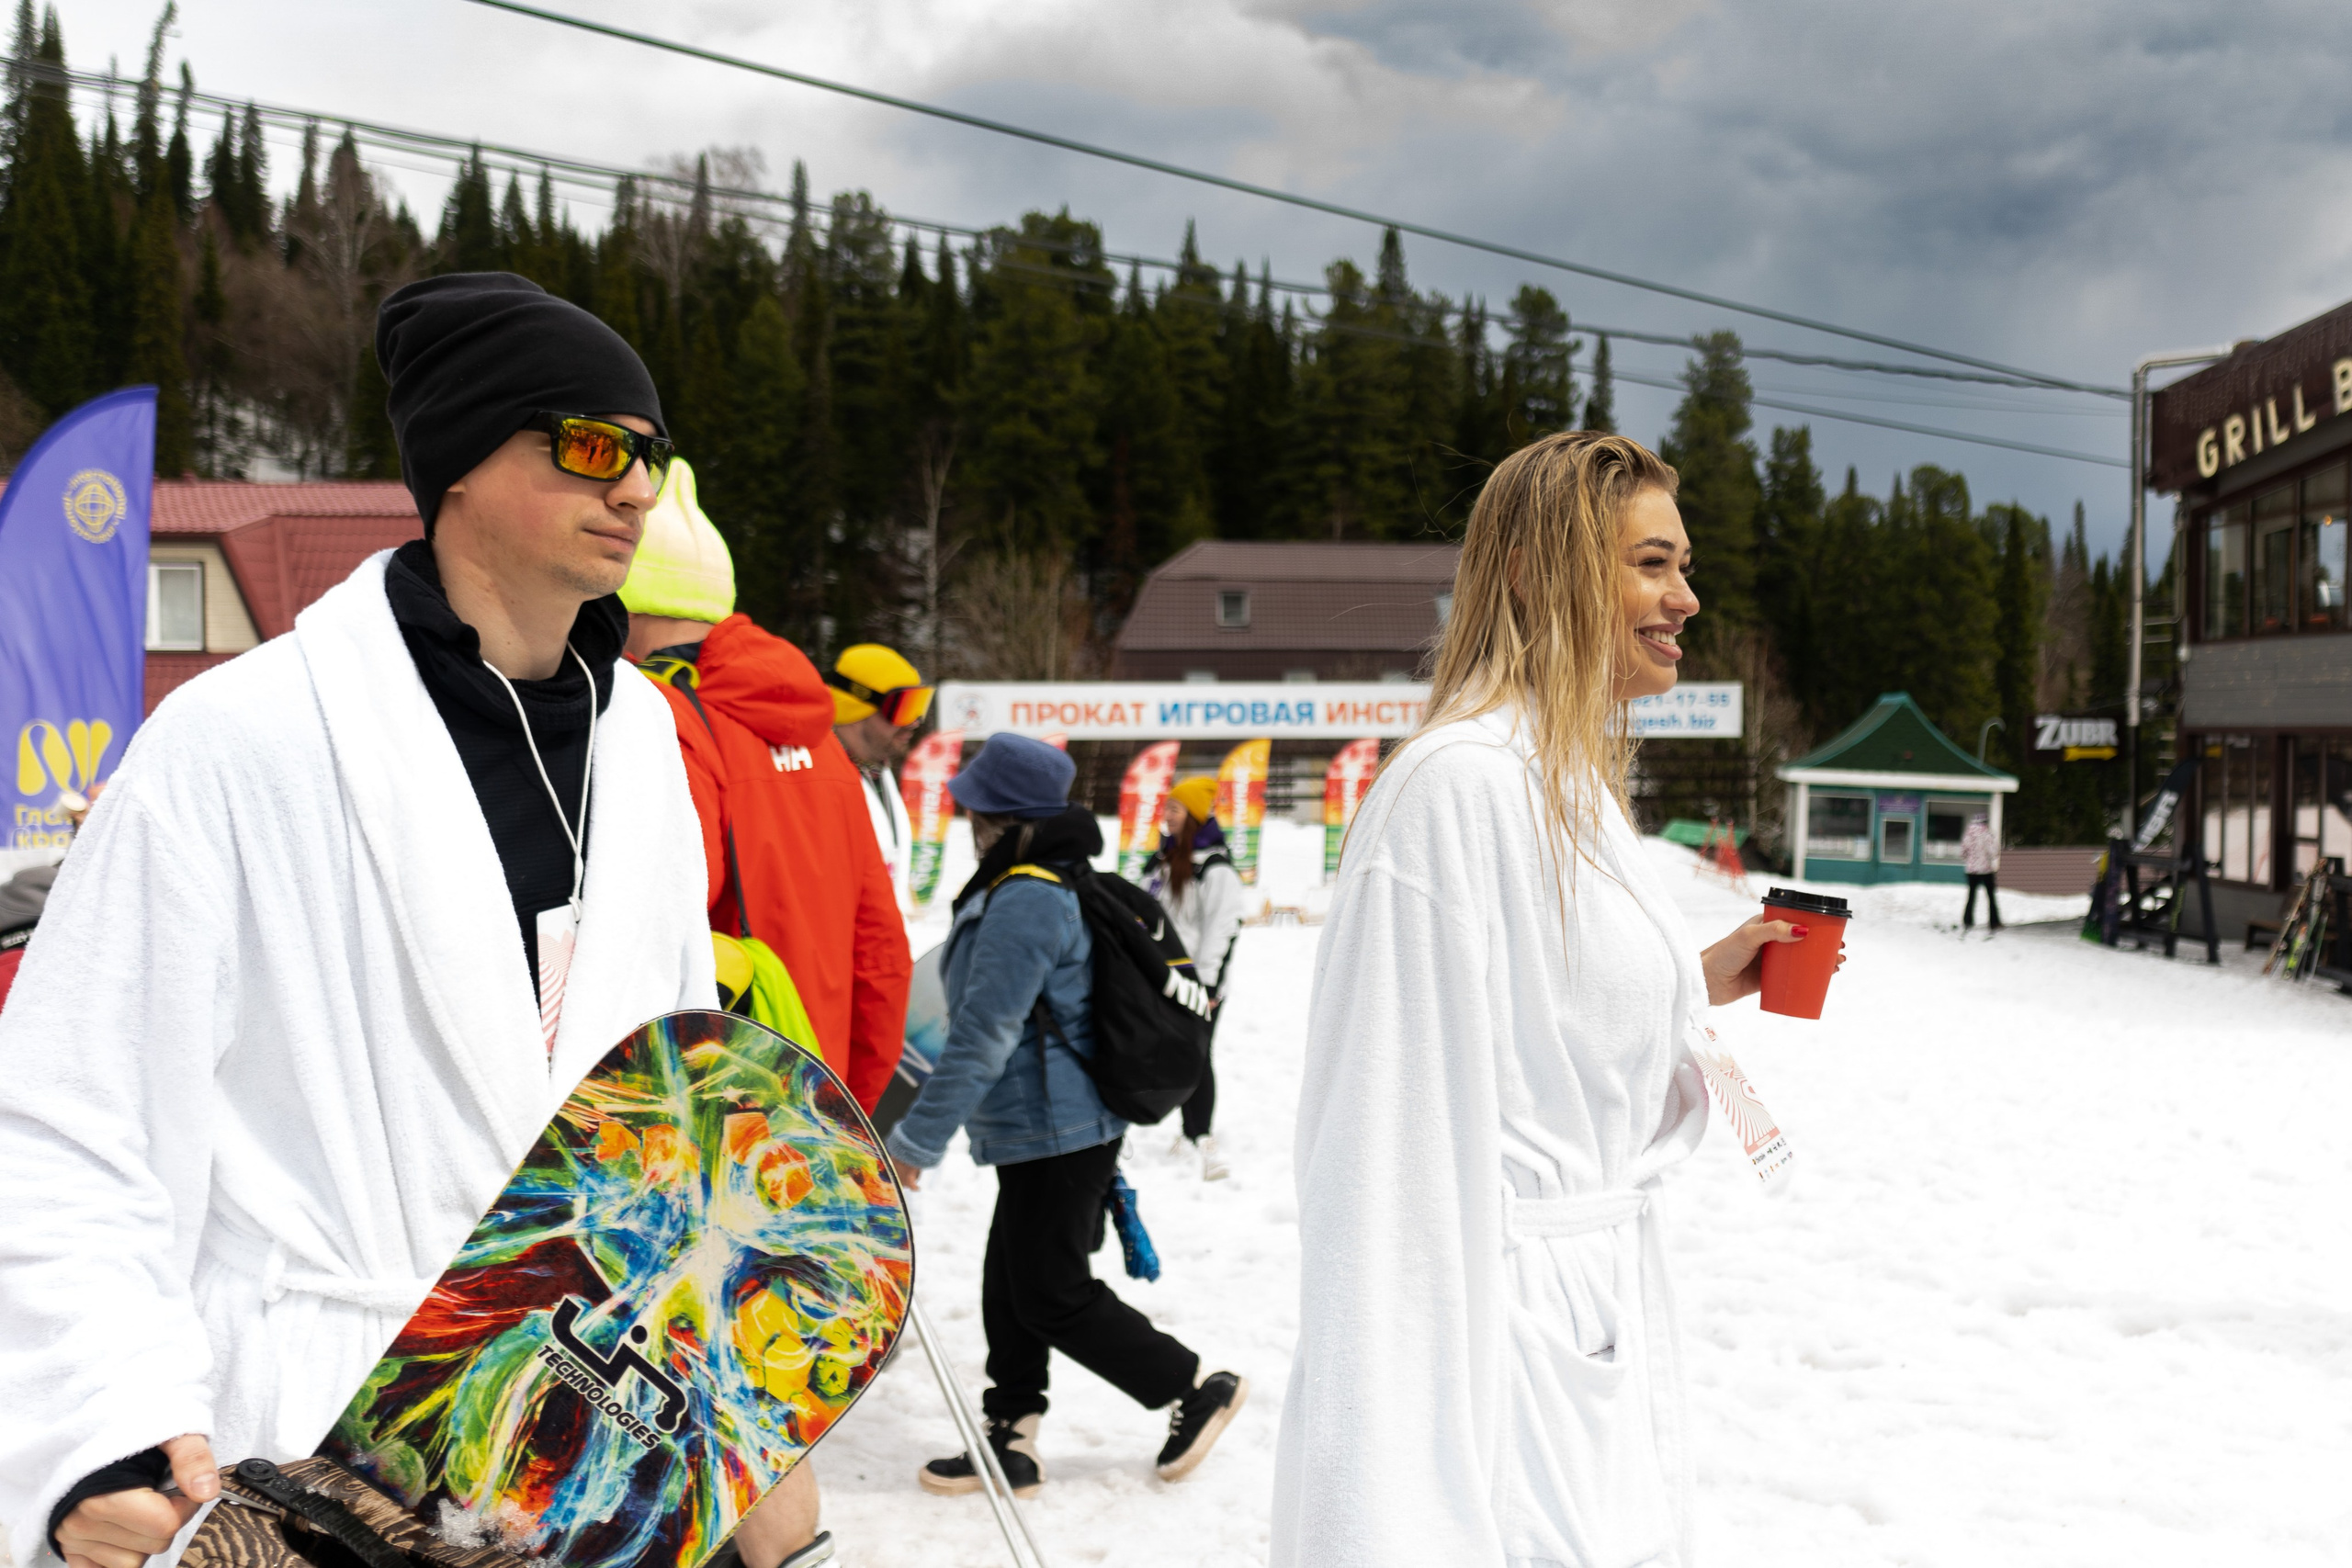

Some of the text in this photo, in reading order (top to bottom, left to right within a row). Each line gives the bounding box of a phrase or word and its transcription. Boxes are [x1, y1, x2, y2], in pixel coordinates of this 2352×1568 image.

[2196, 383, 2318, 479] GRILL
[1011, 701, 1146, 726] ПРОКАТ
[1159, 701, 1315, 726] ИГРОВАЯ
[537, 1344, 662, 1450] TECHNOLOGIES
